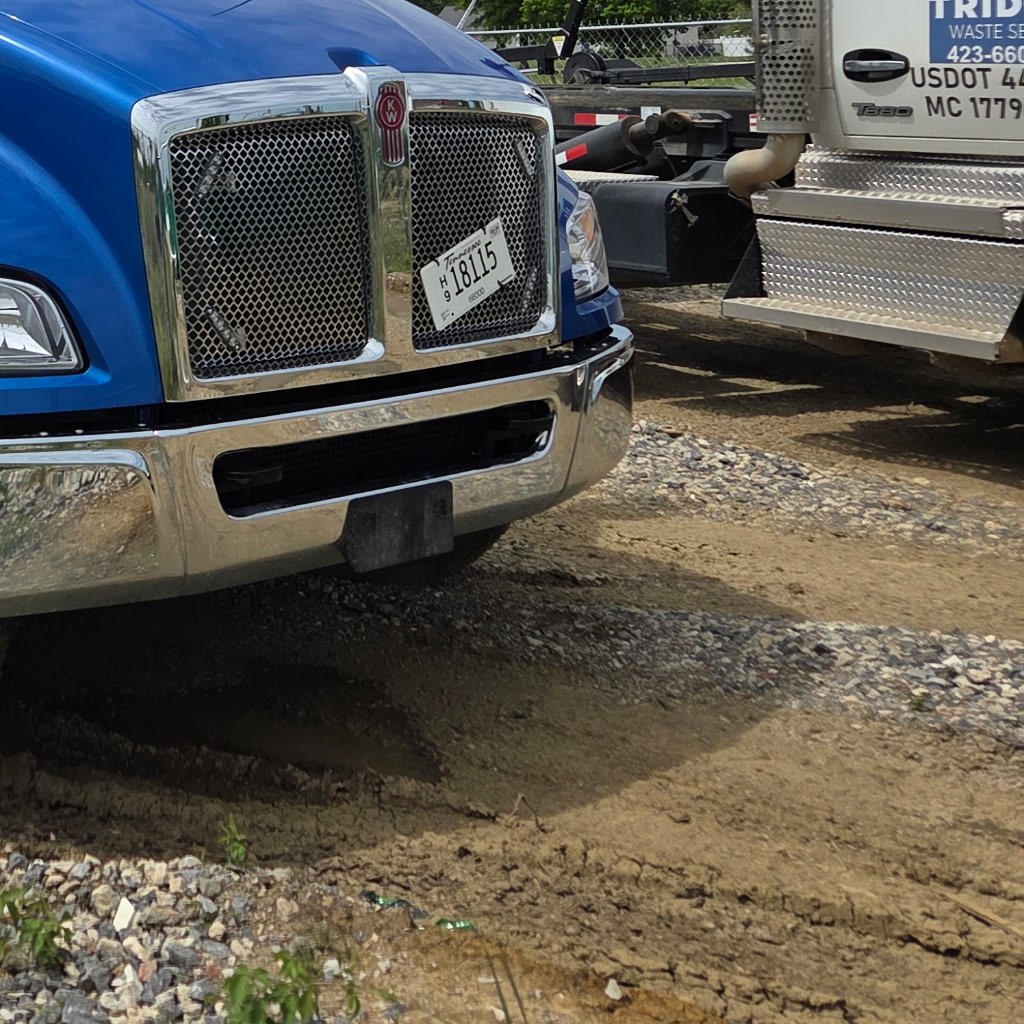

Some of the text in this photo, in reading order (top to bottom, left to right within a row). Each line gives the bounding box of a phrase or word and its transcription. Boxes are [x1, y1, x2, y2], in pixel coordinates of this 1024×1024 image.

[949, 24, 1003, 39] WASTE
[910, 67, 992, 89] USDOT
[925, 96, 963, 118] MC
[450, 241, 497, 296] 18115
